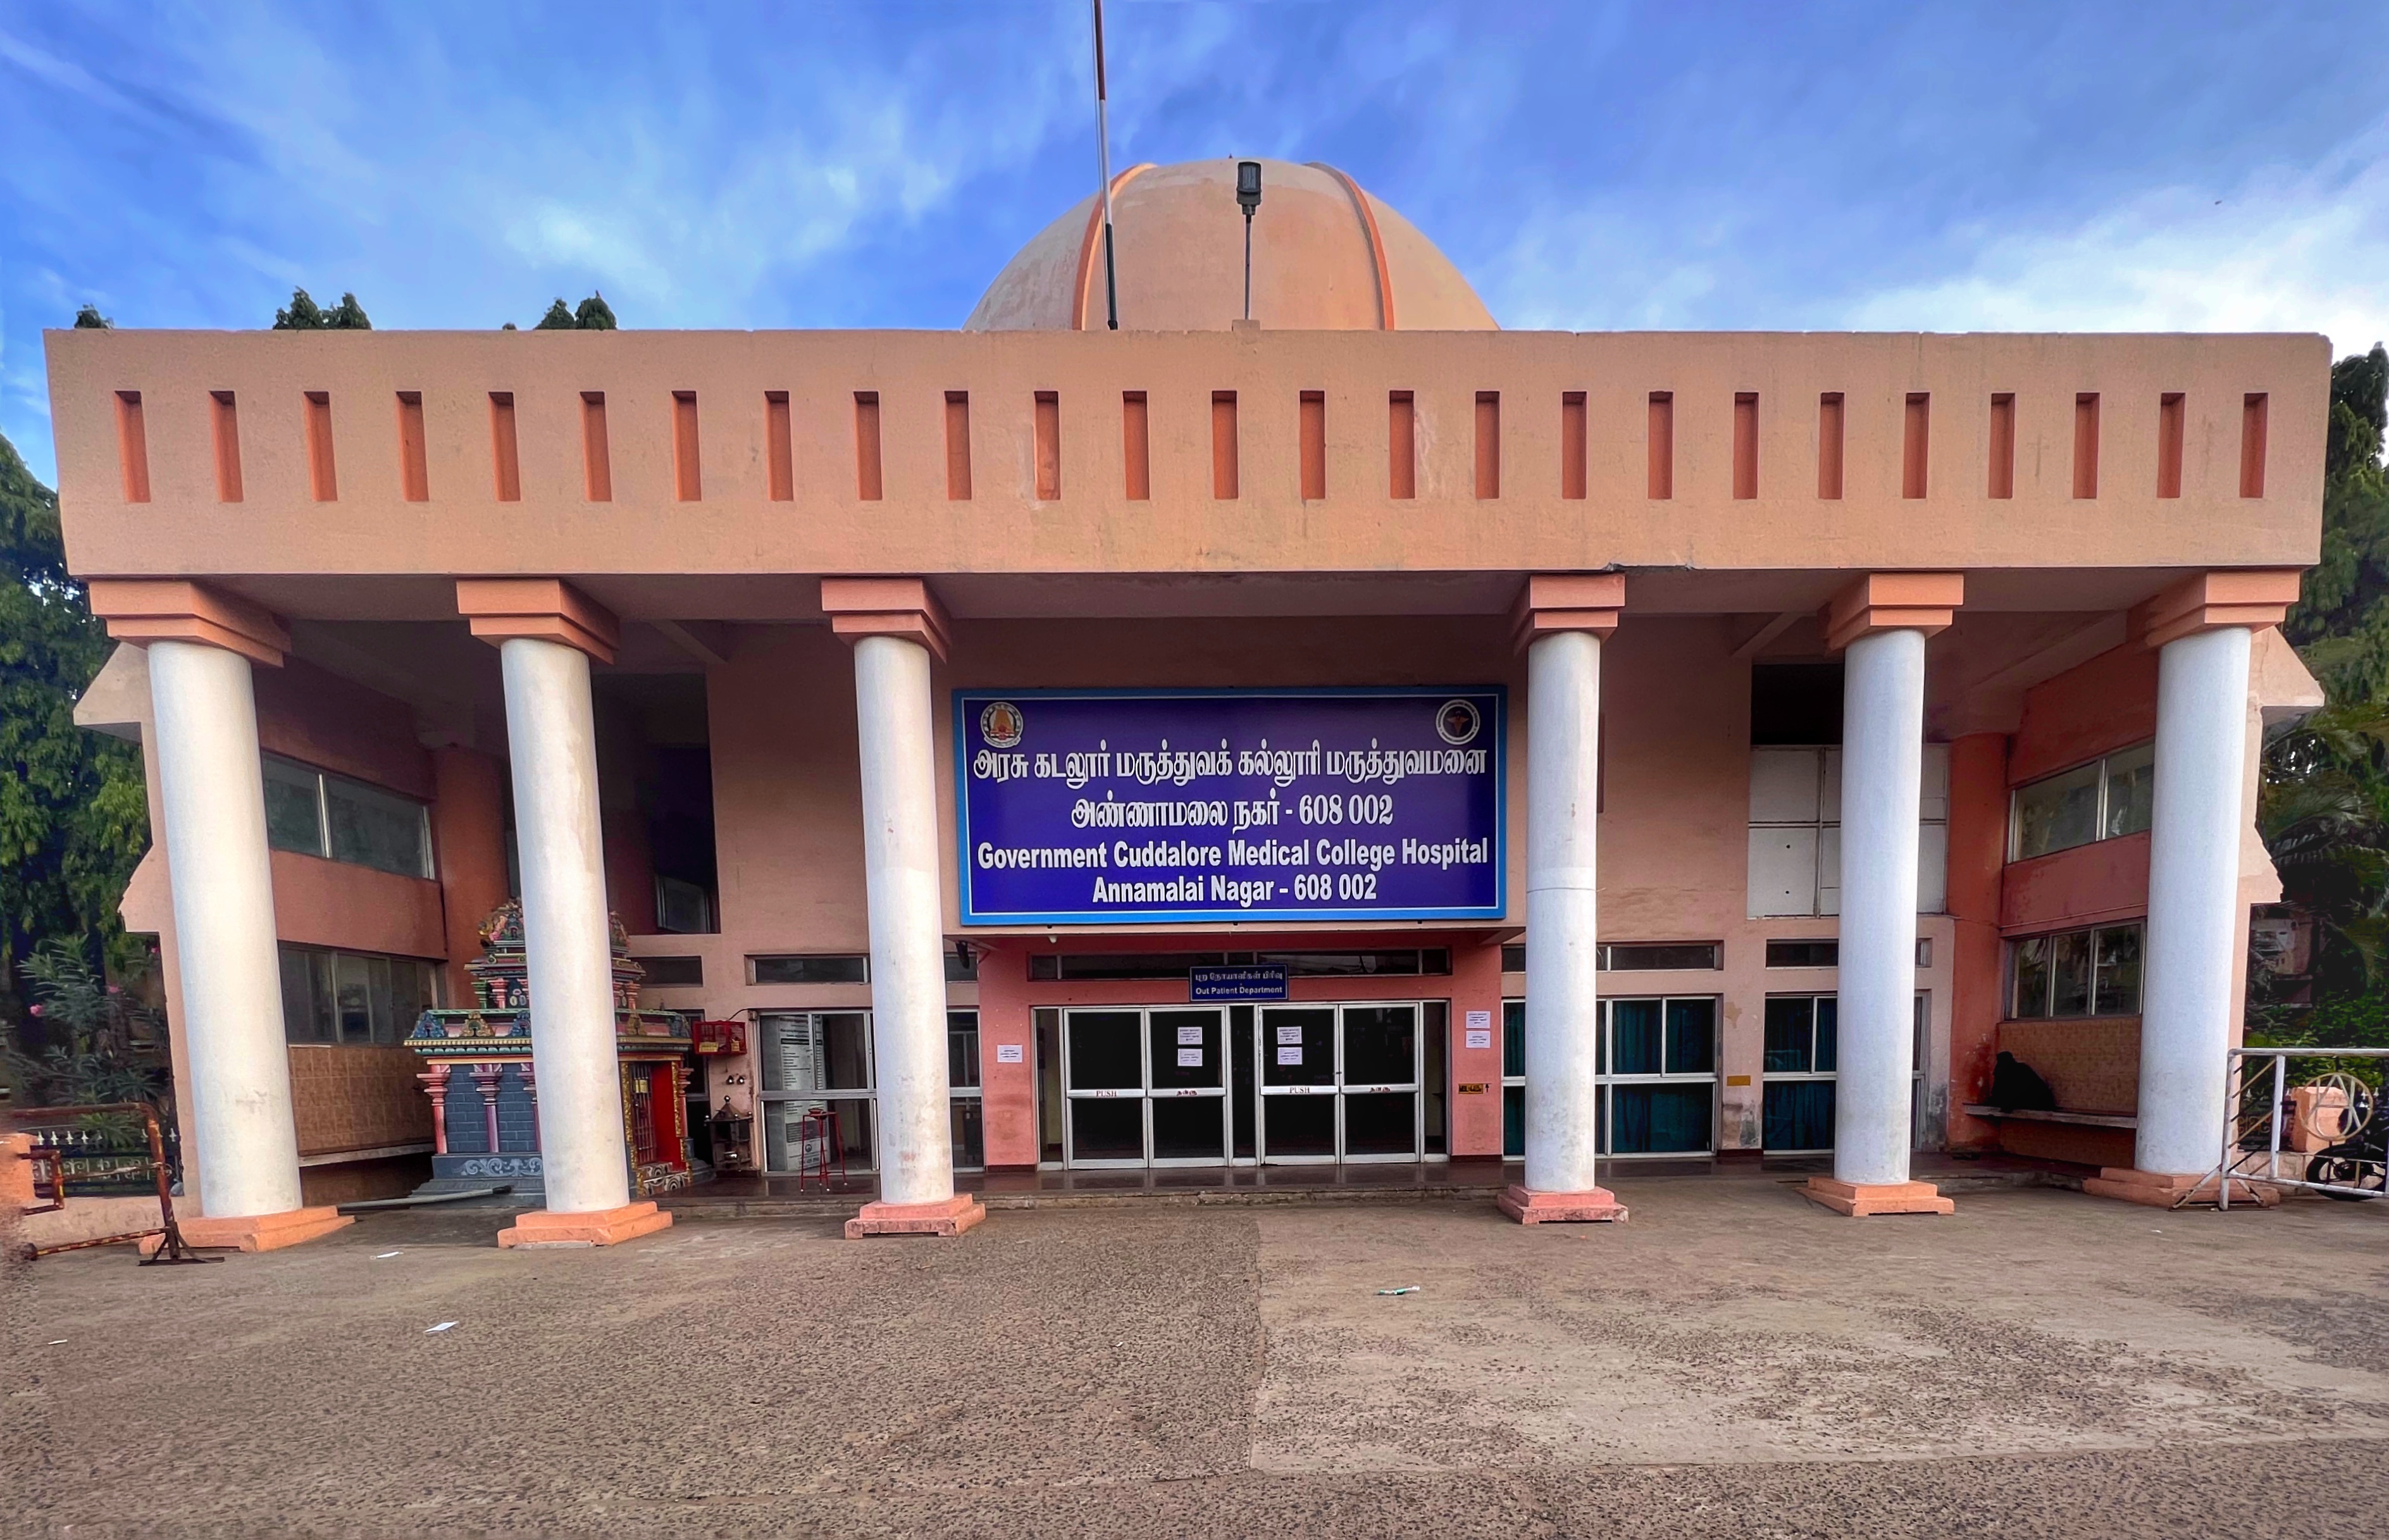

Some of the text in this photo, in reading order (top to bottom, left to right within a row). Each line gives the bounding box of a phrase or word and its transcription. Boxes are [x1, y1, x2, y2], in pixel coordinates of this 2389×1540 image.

[973, 738, 1487, 790] அரசு கடலூர் மருத்துவக் கல்லூரி மருத்துவமனை
[1071, 790, 1228, 828] அண்ணாமலை
[1232, 787, 1281, 835] நகர்
[1299, 794, 1343, 825] 608
[1348, 794, 1393, 825] 002
[977, 837, 1487, 872] Government Cuddalore Medical College Hospital
[1092, 875, 1204, 903] Annamalai
[1211, 875, 1275, 908] Nagar
[1294, 874, 1332, 900] 608
[1339, 873, 1377, 900] 002
[1239, 986, 1282, 995] Department
